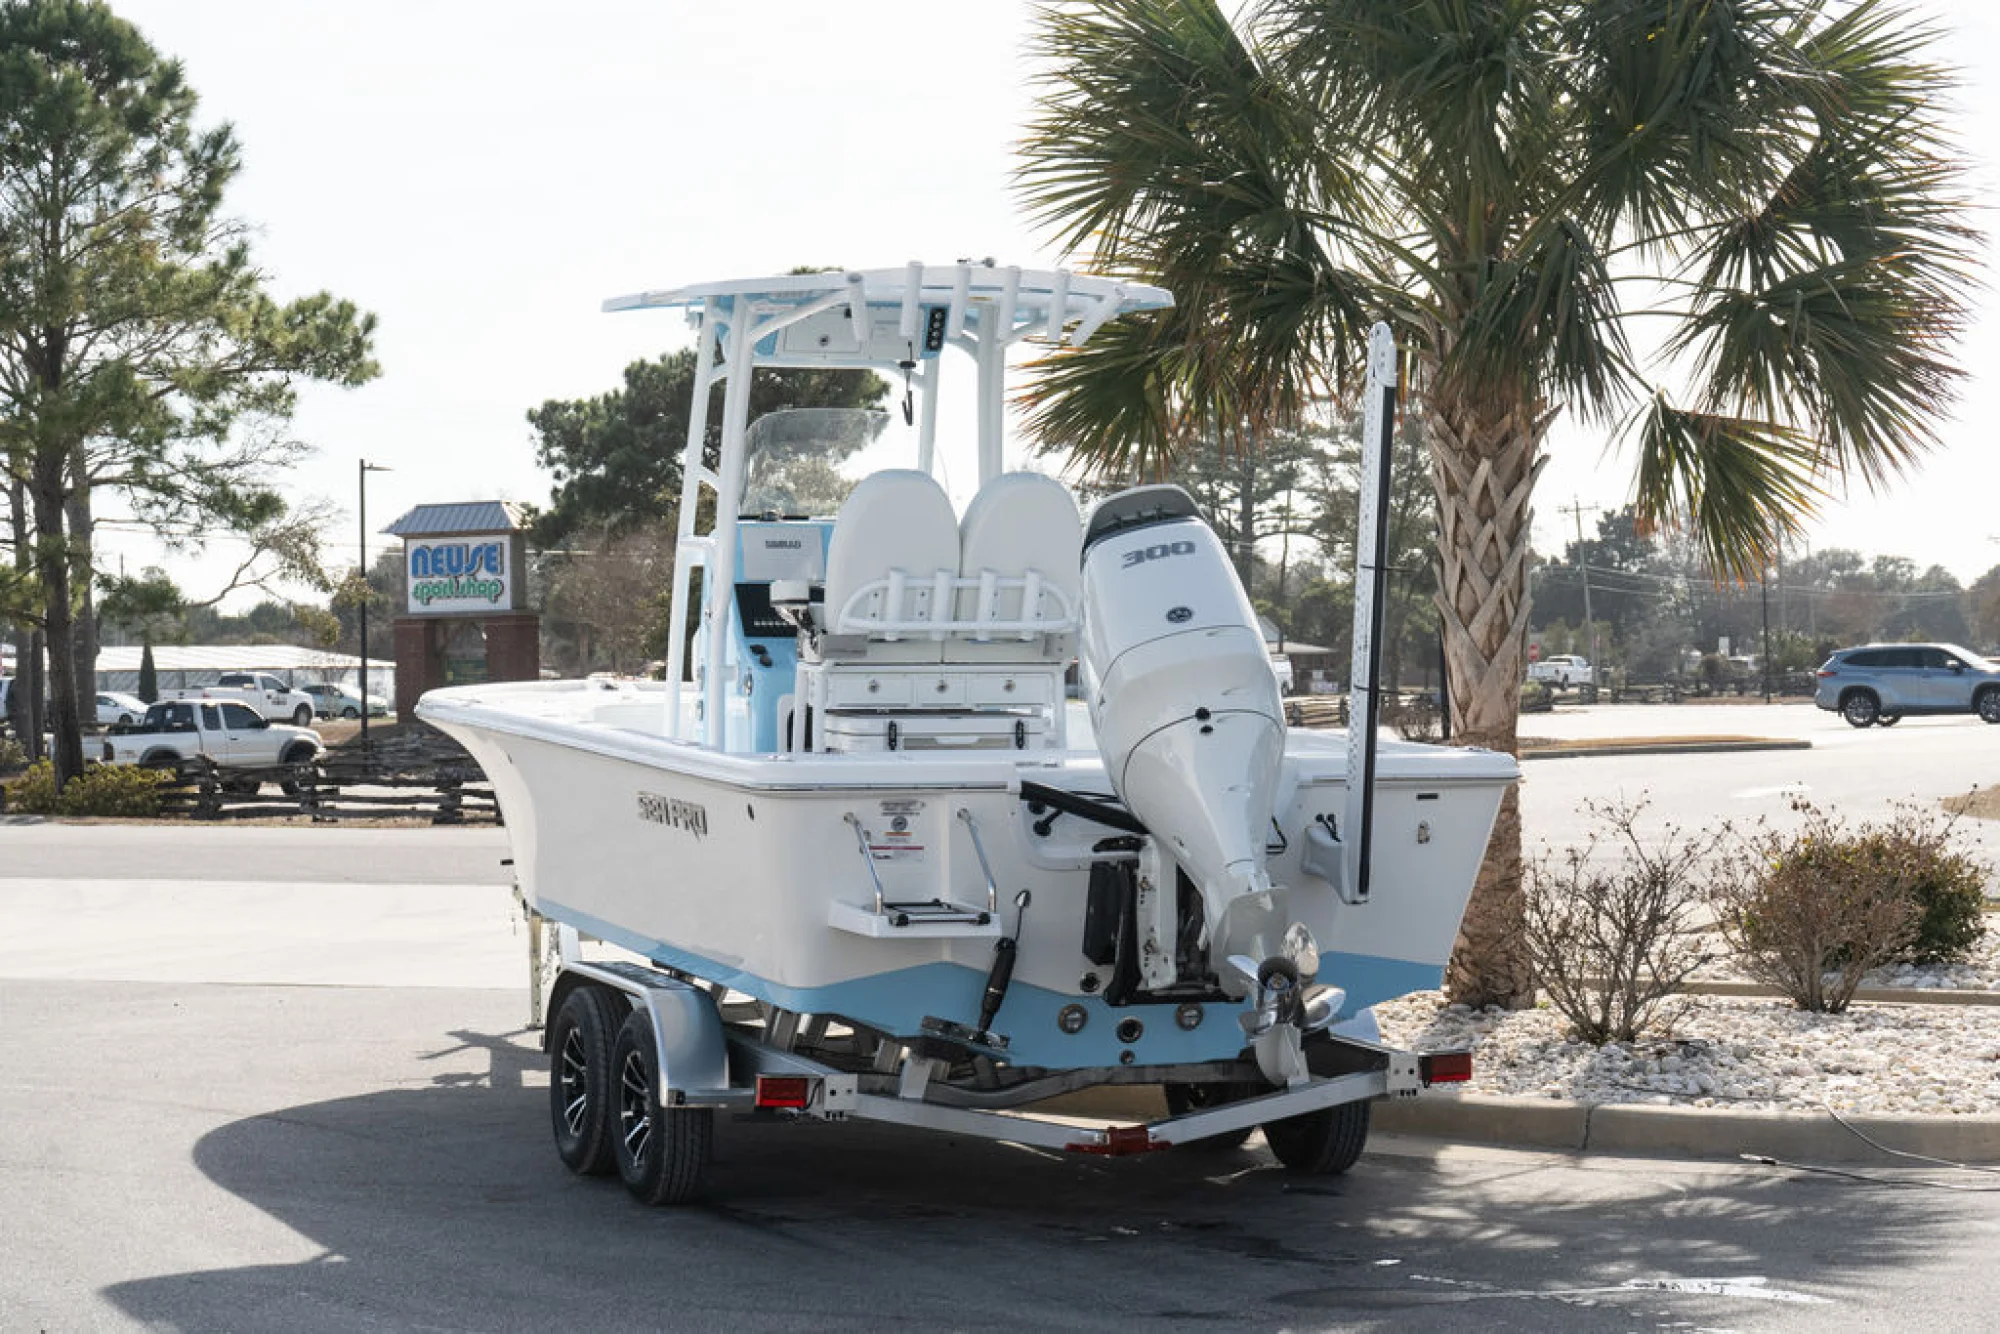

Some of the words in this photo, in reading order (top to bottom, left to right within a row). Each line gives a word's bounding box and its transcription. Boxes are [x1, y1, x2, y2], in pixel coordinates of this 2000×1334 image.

[411, 543, 503, 578] NEUSE
[1121, 540, 1196, 569] 300
[459, 575, 505, 604] shop
